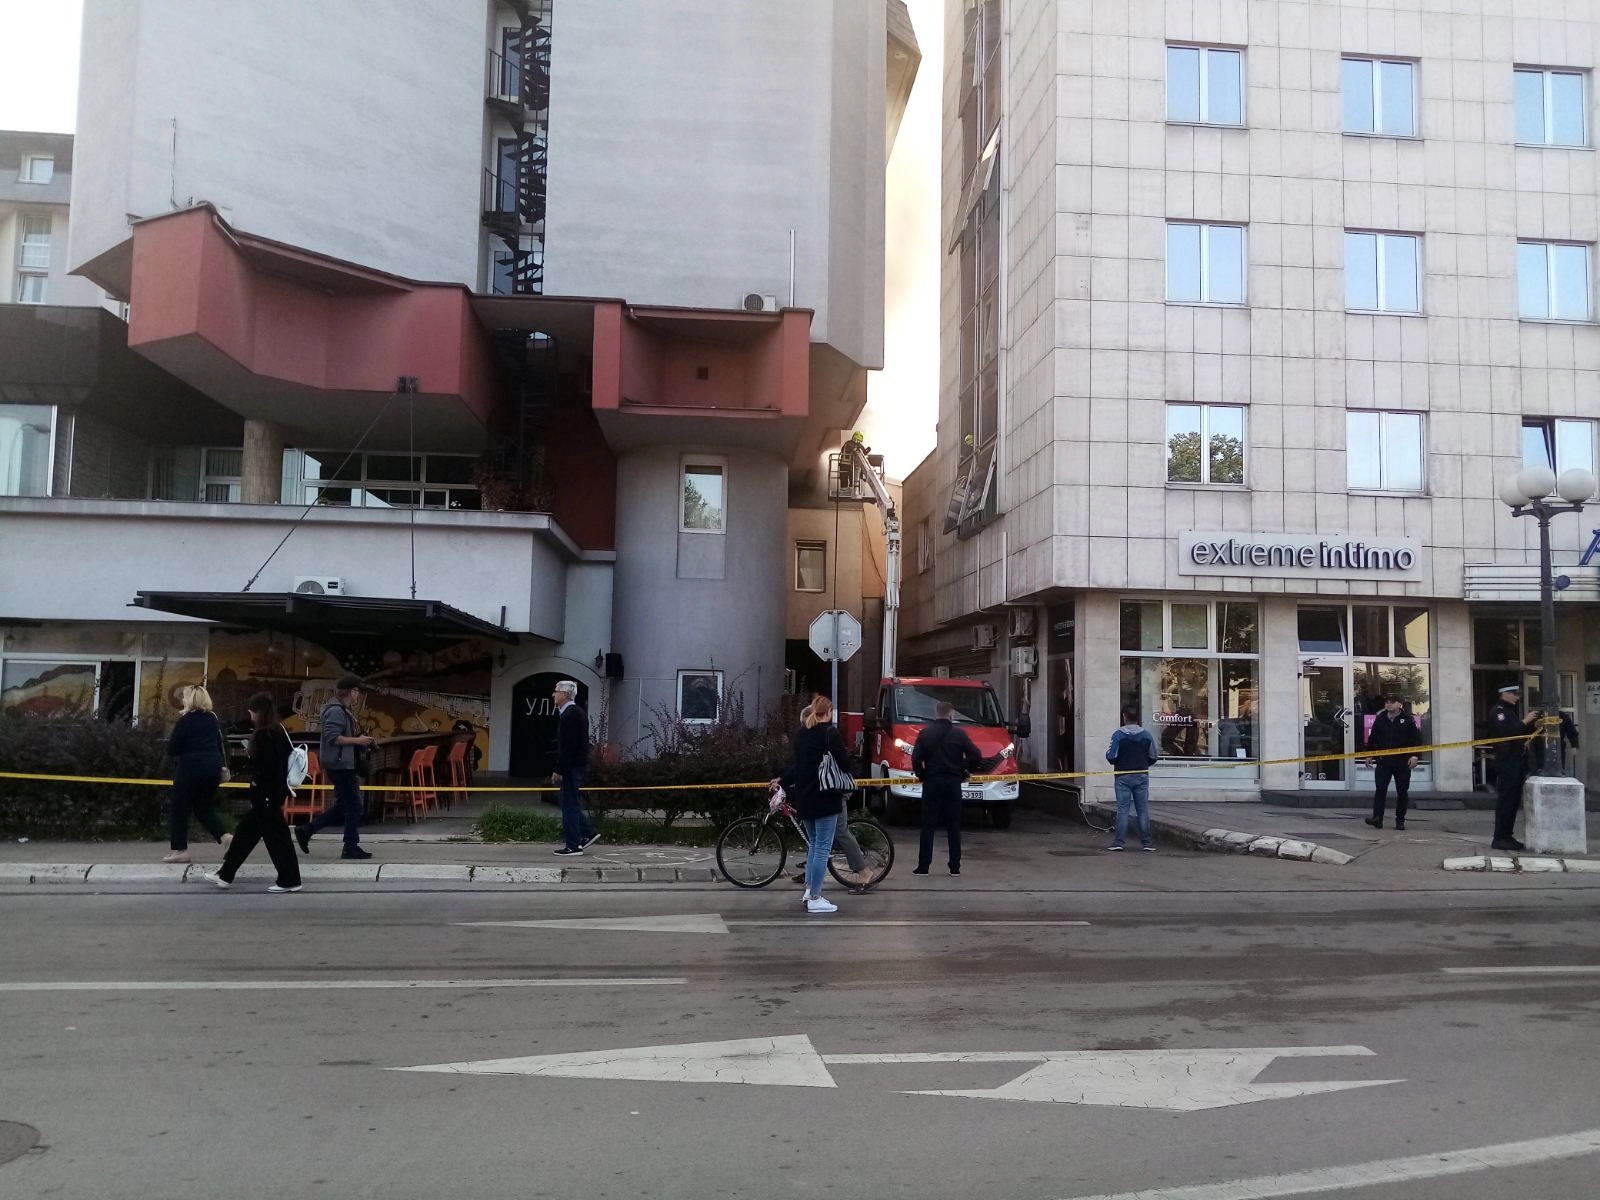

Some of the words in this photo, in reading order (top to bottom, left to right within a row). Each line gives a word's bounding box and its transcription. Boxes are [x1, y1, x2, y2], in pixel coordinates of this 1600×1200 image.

[1191, 539, 1316, 567] extreme
[1319, 541, 1416, 570] intimo
[1152, 712, 1193, 723] Comfort
